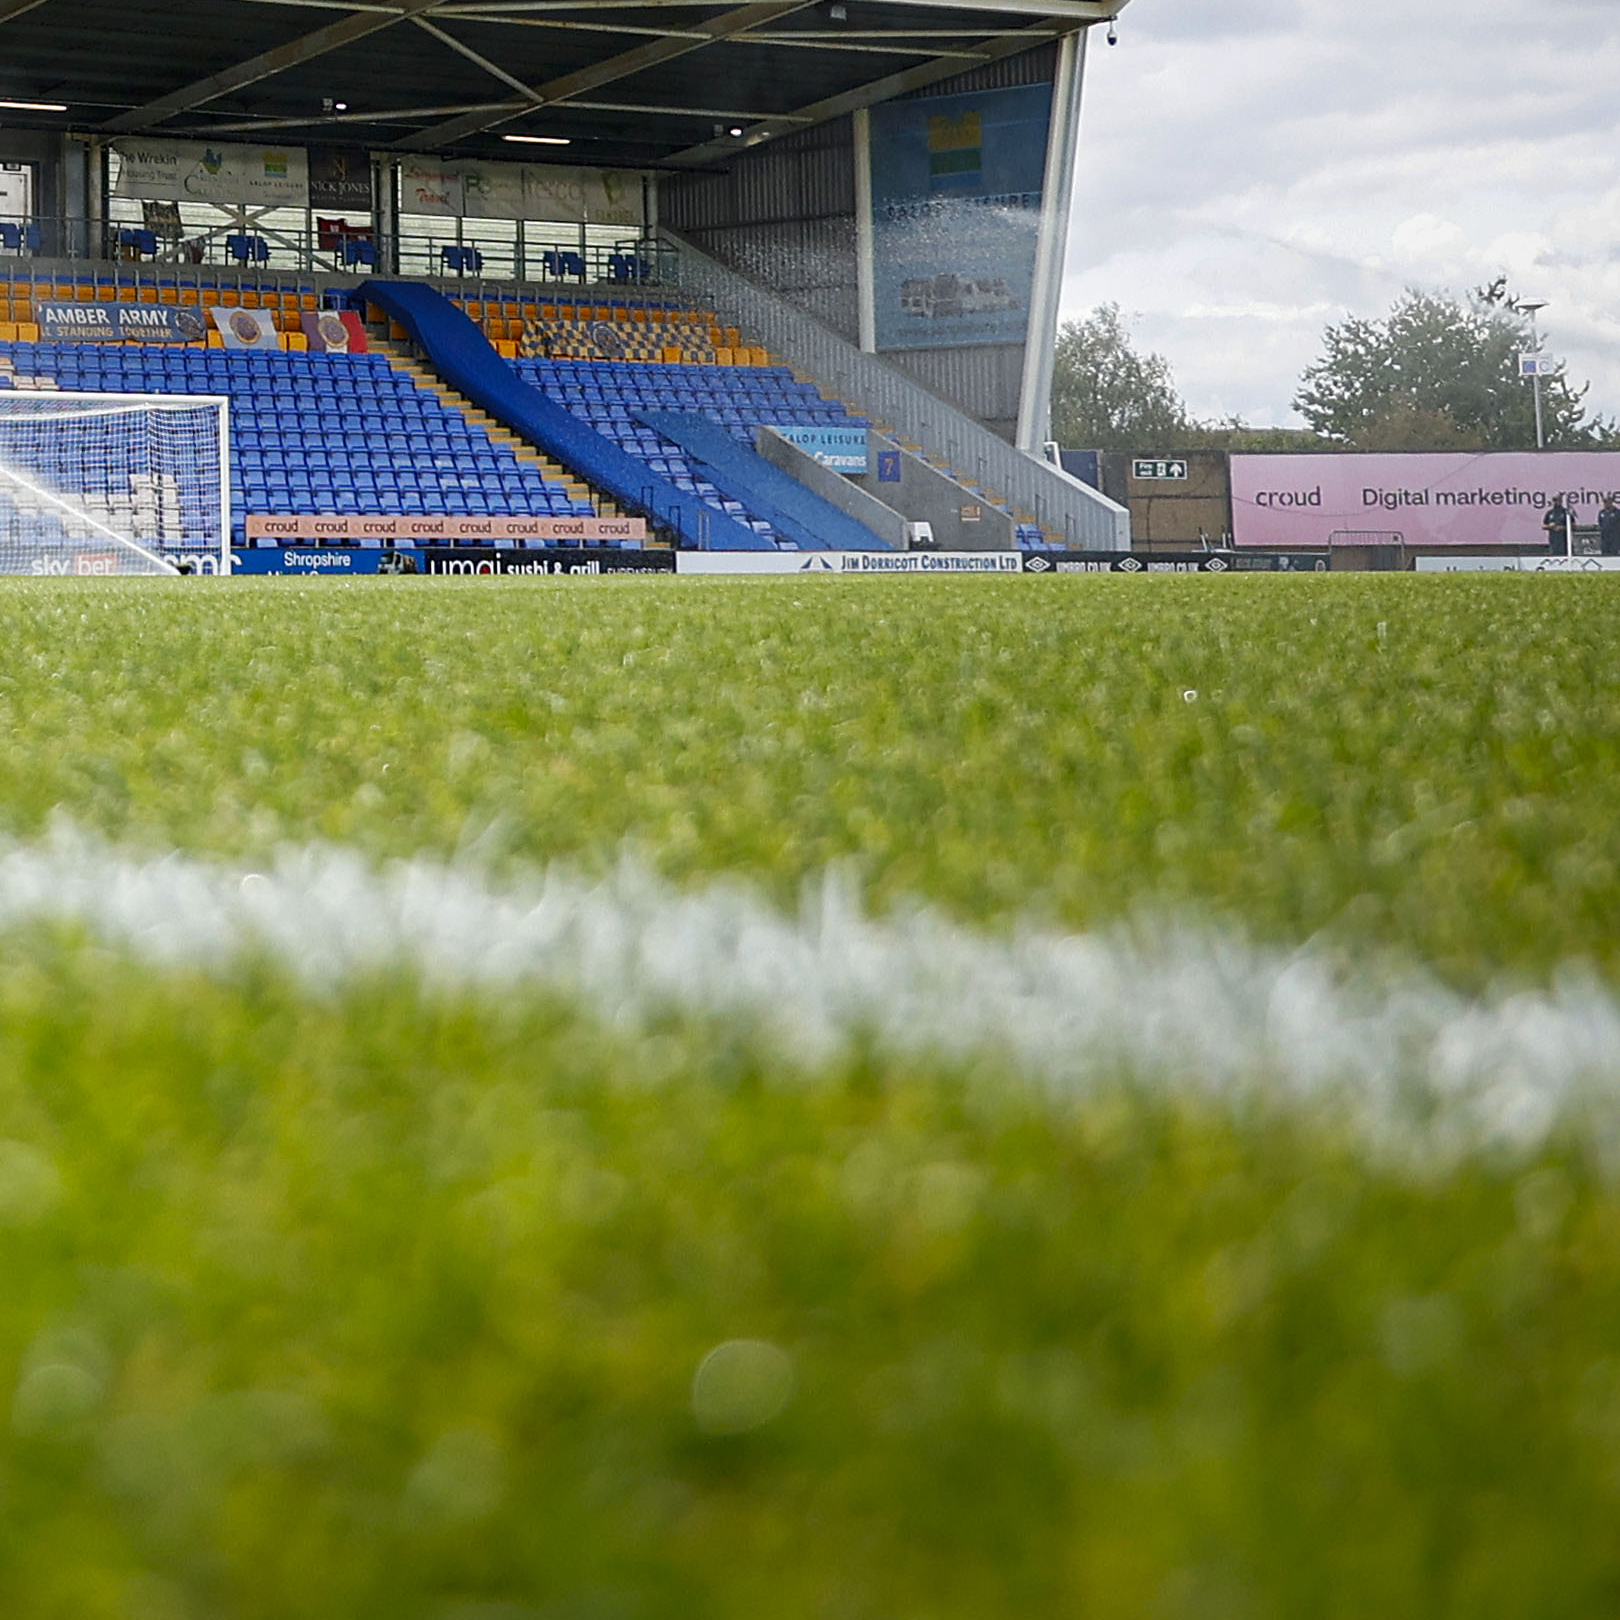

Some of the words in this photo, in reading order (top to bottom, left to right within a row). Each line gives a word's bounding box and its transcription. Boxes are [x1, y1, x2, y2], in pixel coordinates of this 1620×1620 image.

[339, 181, 370, 195] JONES
[119, 308, 168, 326] ARMY
[56, 326, 113, 337] STANDING
[821, 434, 866, 445] LEISURE
[815, 451, 867, 468] Caravans
[1255, 485, 1321, 507] croud
[1362, 487, 1429, 510] Digital
[1435, 487, 1553, 510] marketing,
[265, 518, 299, 534] croud
[314, 518, 348, 534] croud
[363, 518, 396, 534] croud
[412, 518, 444, 534] croud
[459, 518, 491, 534] croud
[506, 518, 538, 534] croud
[552, 519, 584, 535] croud
[598, 519, 630, 535] croud
[31, 553, 71, 575] sky
[76, 553, 114, 575] bet
[284, 551, 351, 568] Shropshire
[507, 560, 548, 574] sushi
